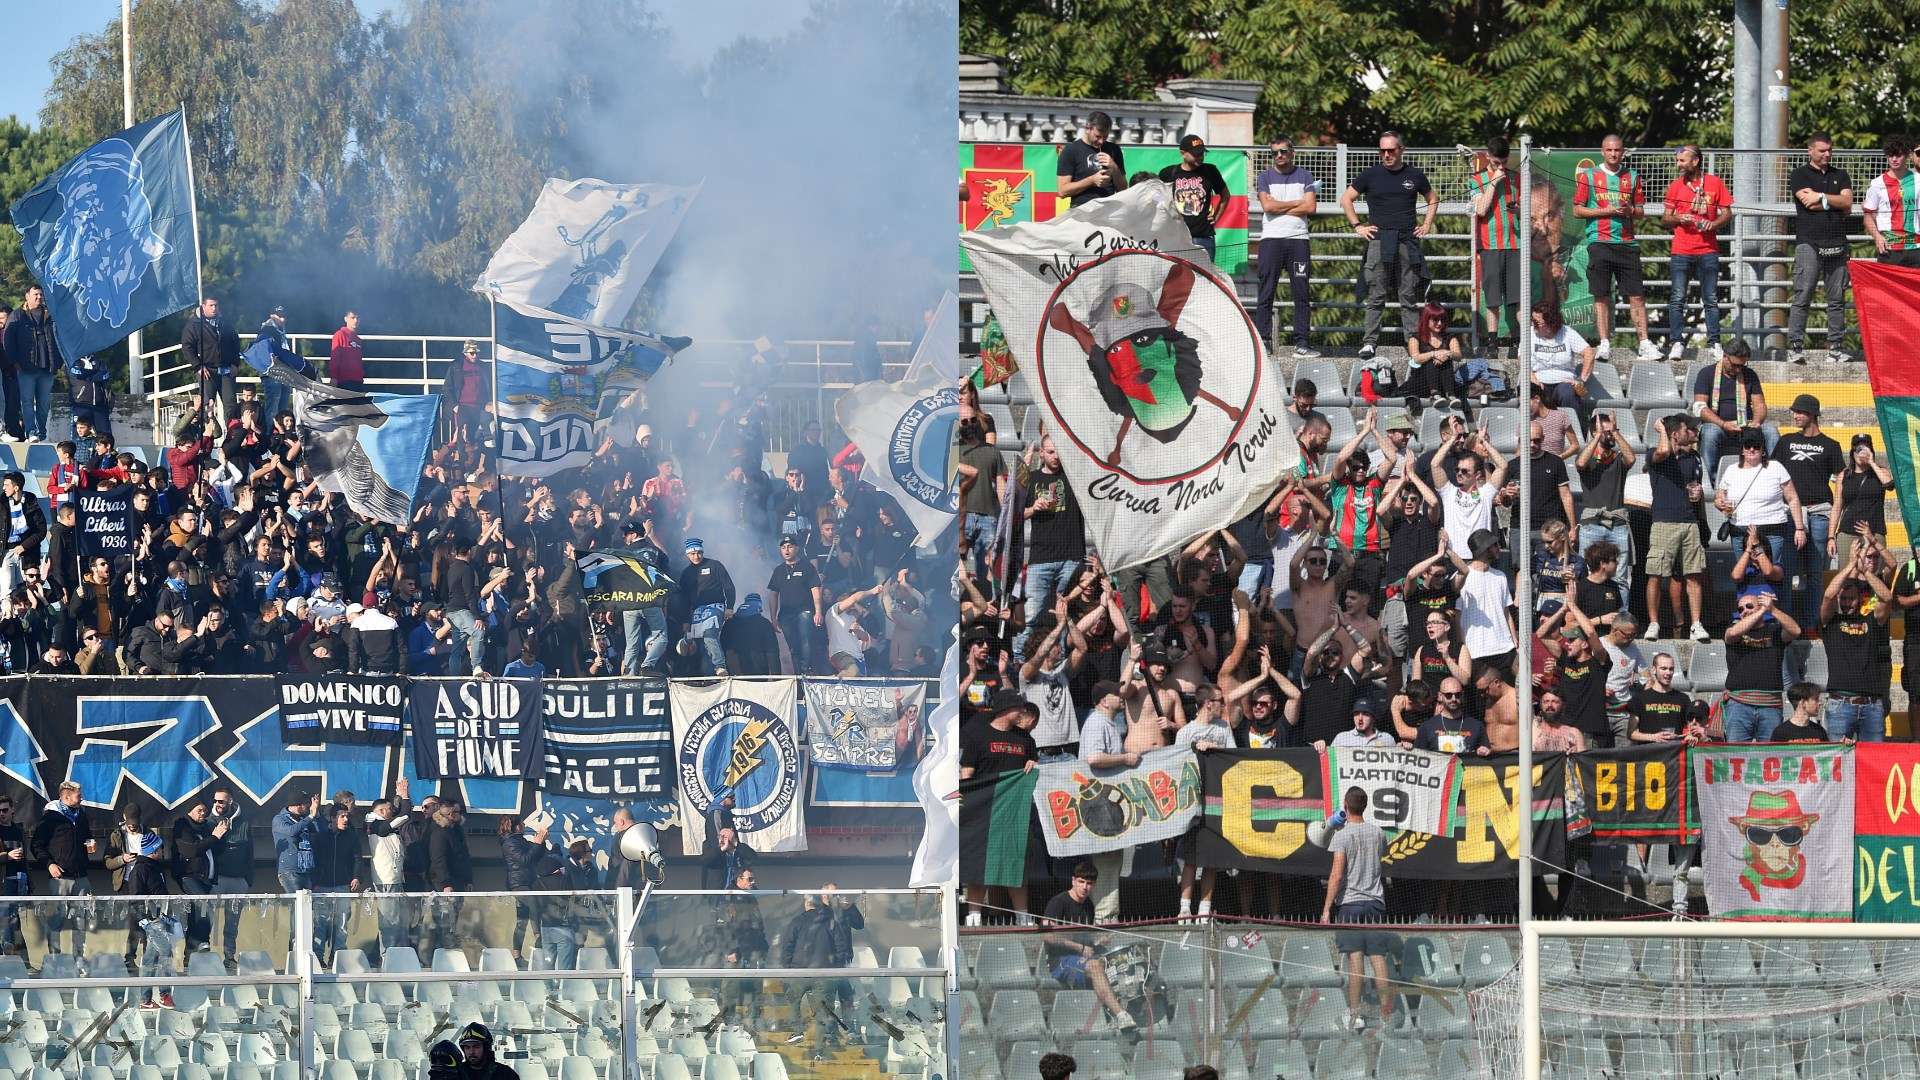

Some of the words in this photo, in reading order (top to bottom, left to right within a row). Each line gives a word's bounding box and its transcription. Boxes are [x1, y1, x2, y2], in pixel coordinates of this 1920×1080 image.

[1039, 253, 1080, 282] The
[1088, 473, 1162, 514] Curva
[1167, 465, 1224, 511] Nord
[1223, 408, 1277, 473] Terni
[1789, 442, 1825, 453] Reebok
[80, 496, 127, 512] Ultras
[84, 516, 126, 533] Liberi
[101, 535, 127, 549] 1936
[586, 591, 633, 605] ESCARA
[281, 681, 400, 708] DOMENICO
[434, 684, 457, 719] A
[459, 681, 521, 719] SUD
[808, 683, 896, 710] MICHEL
[317, 709, 367, 731] VIVE
[457, 719, 496, 739] DEL
[437, 739, 521, 776] FIUME
[1352, 749, 1431, 769] CONTRO
[1704, 756, 1843, 785] INTACCATI
[543, 755, 662, 794] FACCE
[1339, 768, 1441, 790] L'ARTICOLO
[1596, 761, 1667, 812] BIO
[1047, 761, 1202, 840] BOMBA
[1221, 760, 1306, 859] C
[1372, 787, 1410, 825] 9
